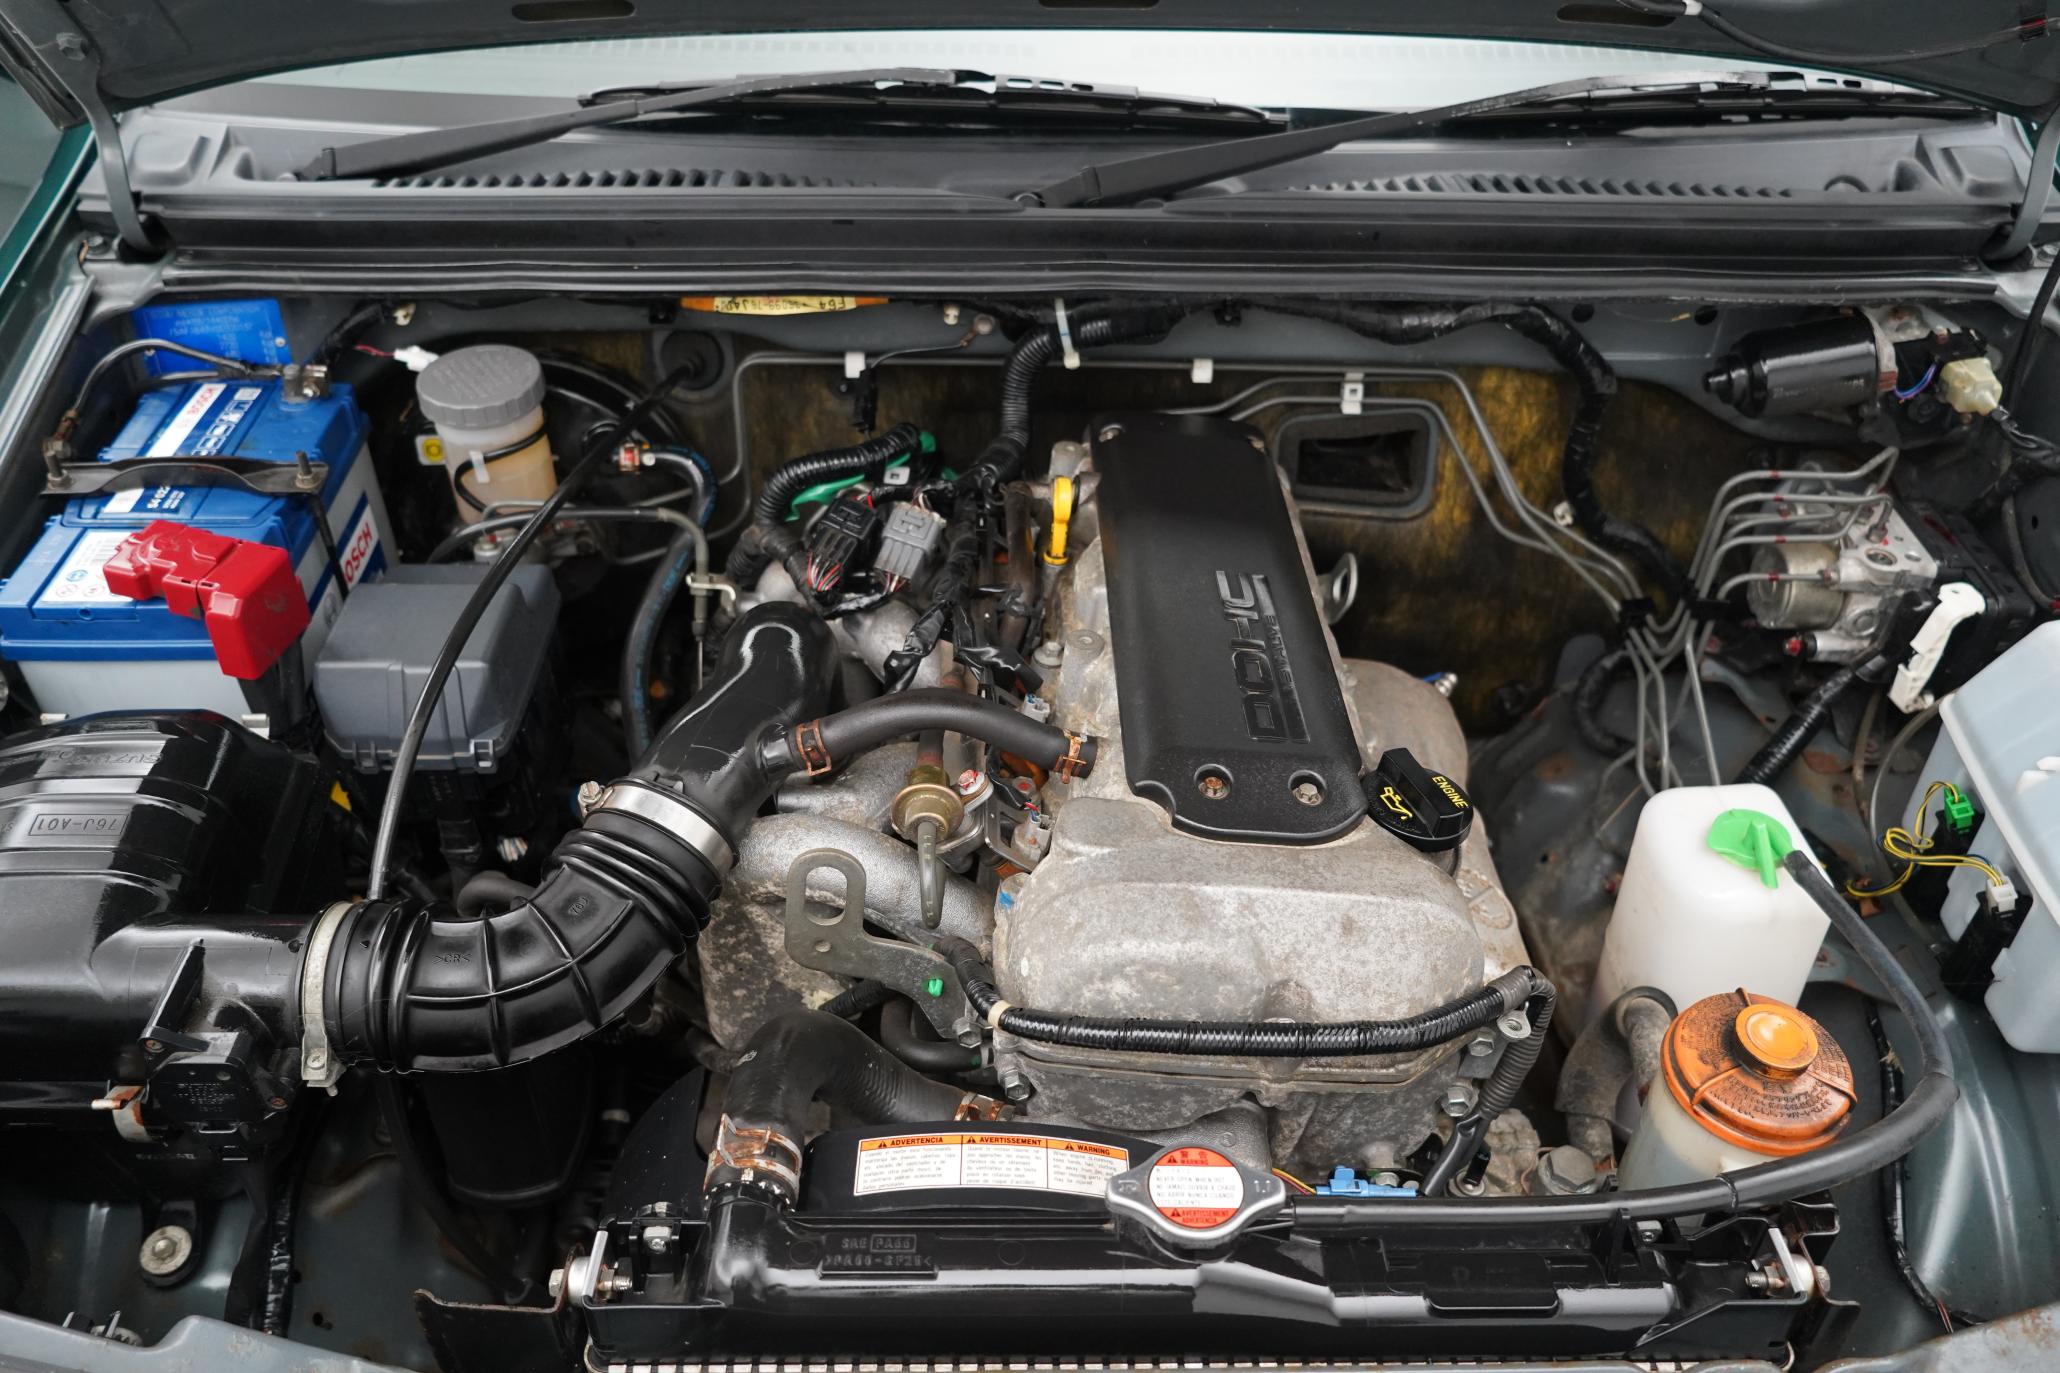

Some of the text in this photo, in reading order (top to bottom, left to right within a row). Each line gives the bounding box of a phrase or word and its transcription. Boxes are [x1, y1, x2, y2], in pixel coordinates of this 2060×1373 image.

[343, 521, 373, 583] OSCH
[1215, 569, 1289, 744] DOHC
[1431, 775, 1468, 810] ENGINE
[37, 817, 118, 831] 76J-A01
[890, 1136, 944, 1147] ADVERTENCIA
[979, 1135, 1042, 1146] AVERTISSEMENT
[1076, 1143, 1111, 1156] WARNING
[1180, 1158, 1209, 1166] WARNING
[1181, 1209, 1229, 1217] AVERTISSEMENT
[1182, 1216, 1218, 1224] ADVERTENCIA
